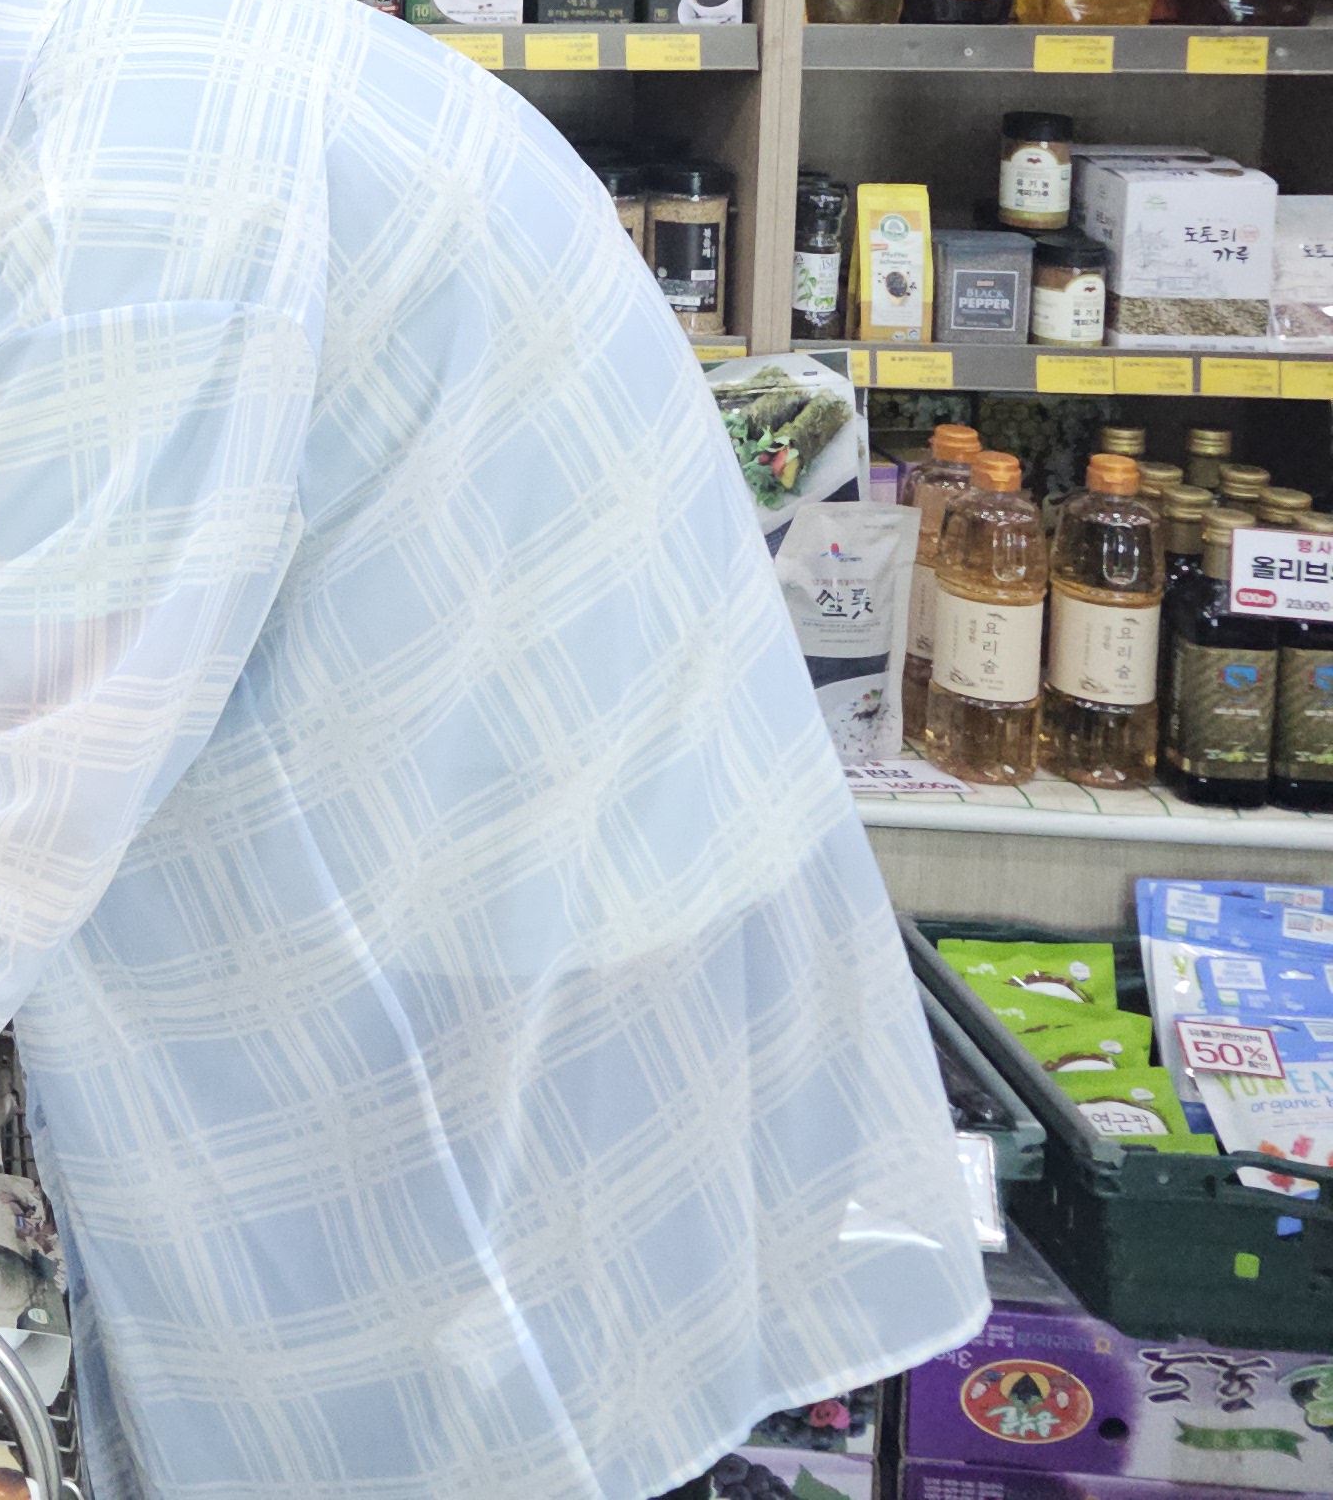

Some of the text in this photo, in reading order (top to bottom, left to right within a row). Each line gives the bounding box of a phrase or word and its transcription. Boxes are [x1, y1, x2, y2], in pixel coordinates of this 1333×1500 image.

[1183, 225, 1237, 244] 도토리
[1213, 246, 1252, 266] 가루
[966, 286, 1004, 298] BLACK
[958, 297, 1011, 311] PEPPER
[1251, 555, 1333, 584] 올리브
[980, 620, 1000, 675] 요리술
[1192, 1040, 1268, 1067] 50%
[1250, 1094, 1321, 1115] organic
